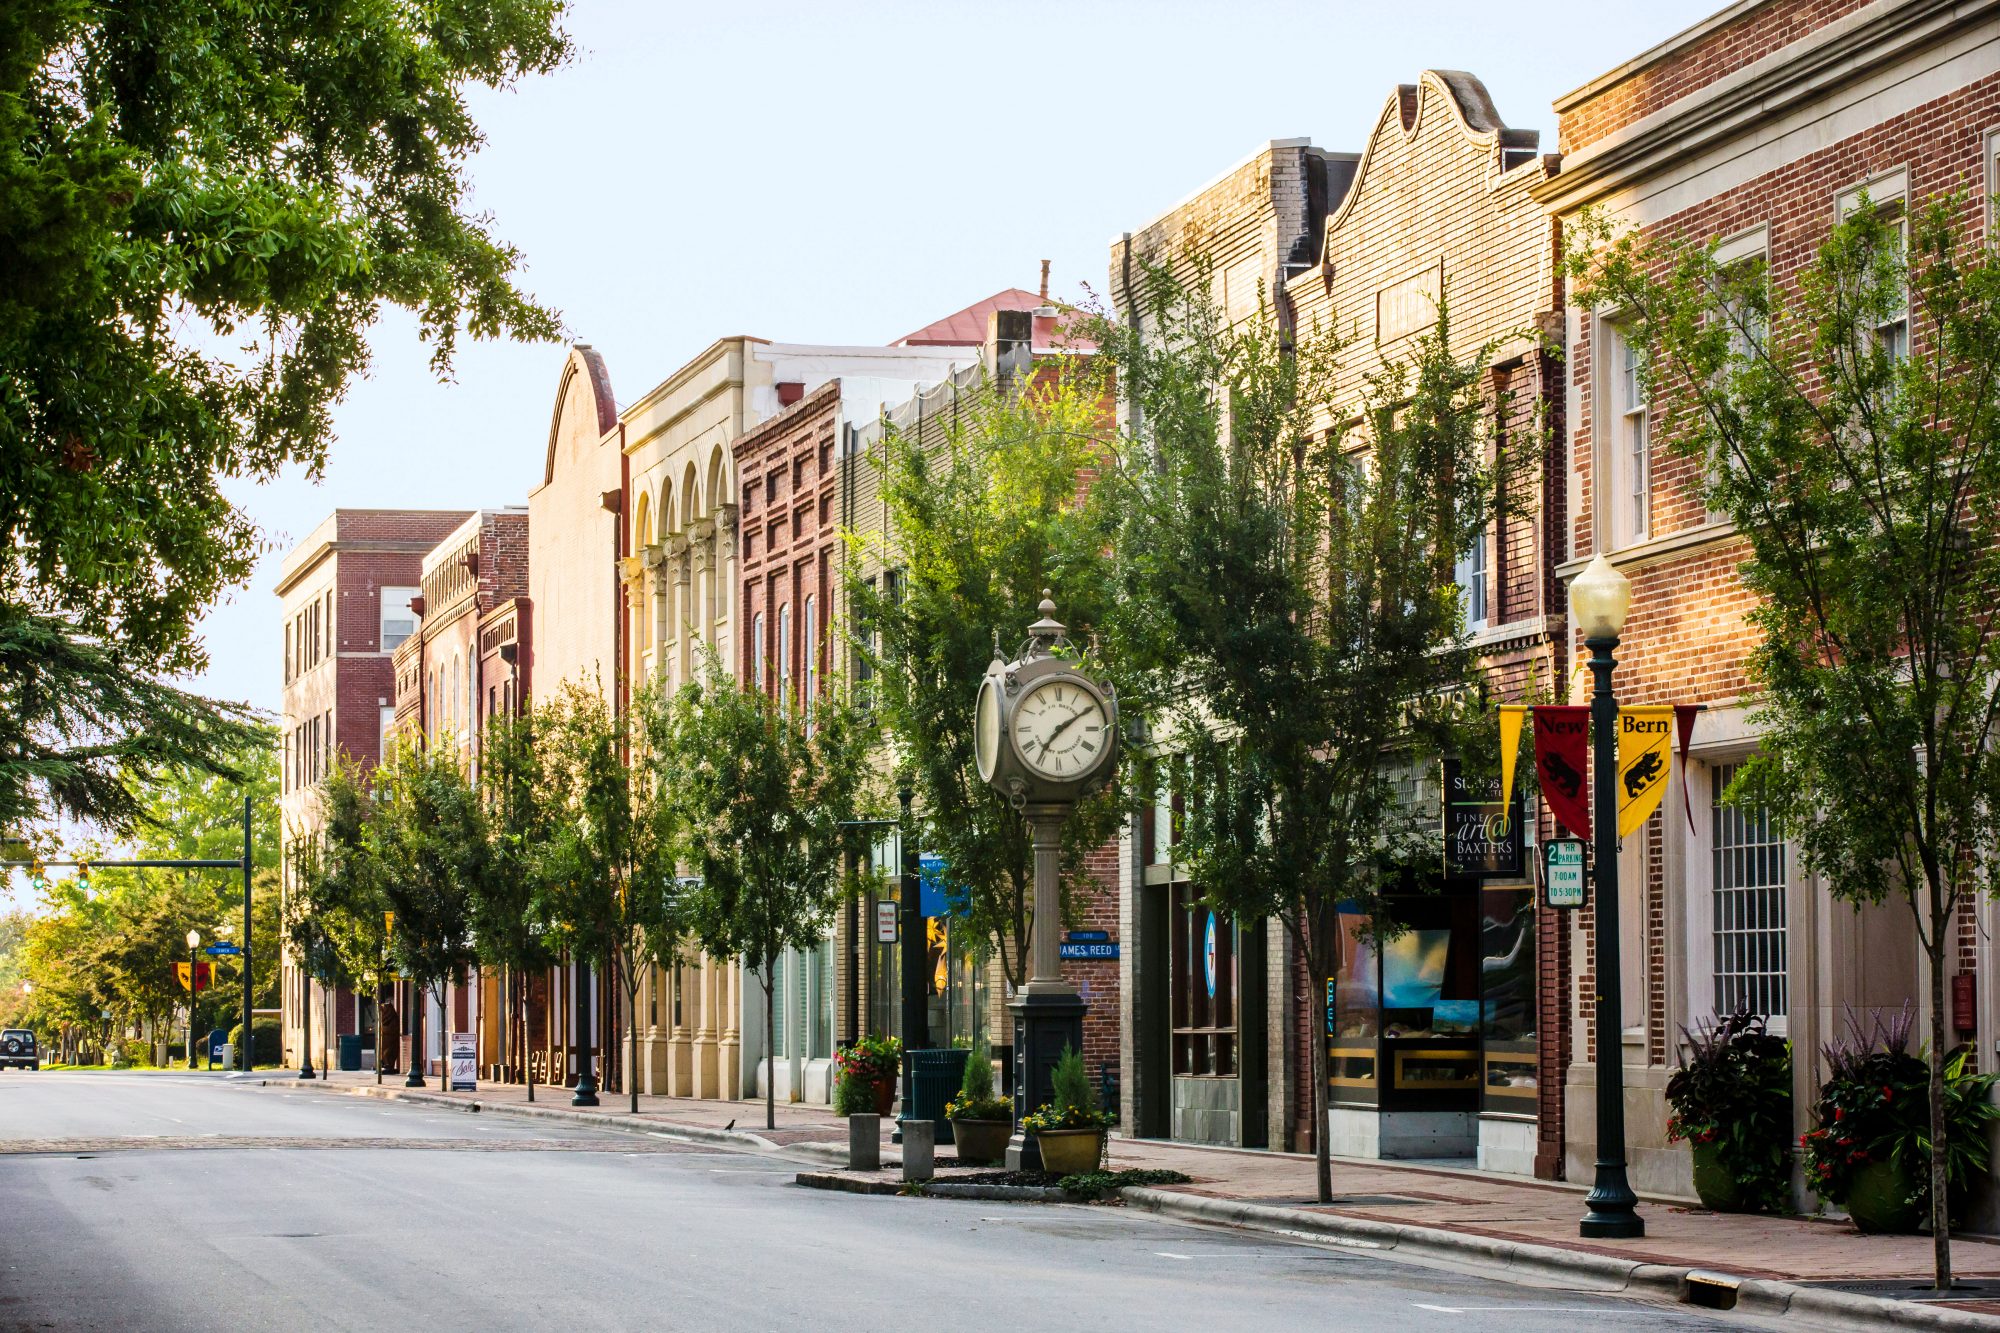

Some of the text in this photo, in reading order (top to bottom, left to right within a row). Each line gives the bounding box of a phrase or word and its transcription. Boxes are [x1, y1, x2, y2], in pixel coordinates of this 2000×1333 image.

[1538, 715, 1669, 734] New Bern
[1456, 812, 1484, 823] FINE
[1457, 841, 1512, 854] BAXTERS
[1548, 844, 1557, 862] 2
[1558, 853, 1583, 863] PARKING
[1554, 871, 1577, 881] 7:00AM
[1550, 887, 1582, 897] TO 5:30PM
[1090, 945, 1112, 955] REED
